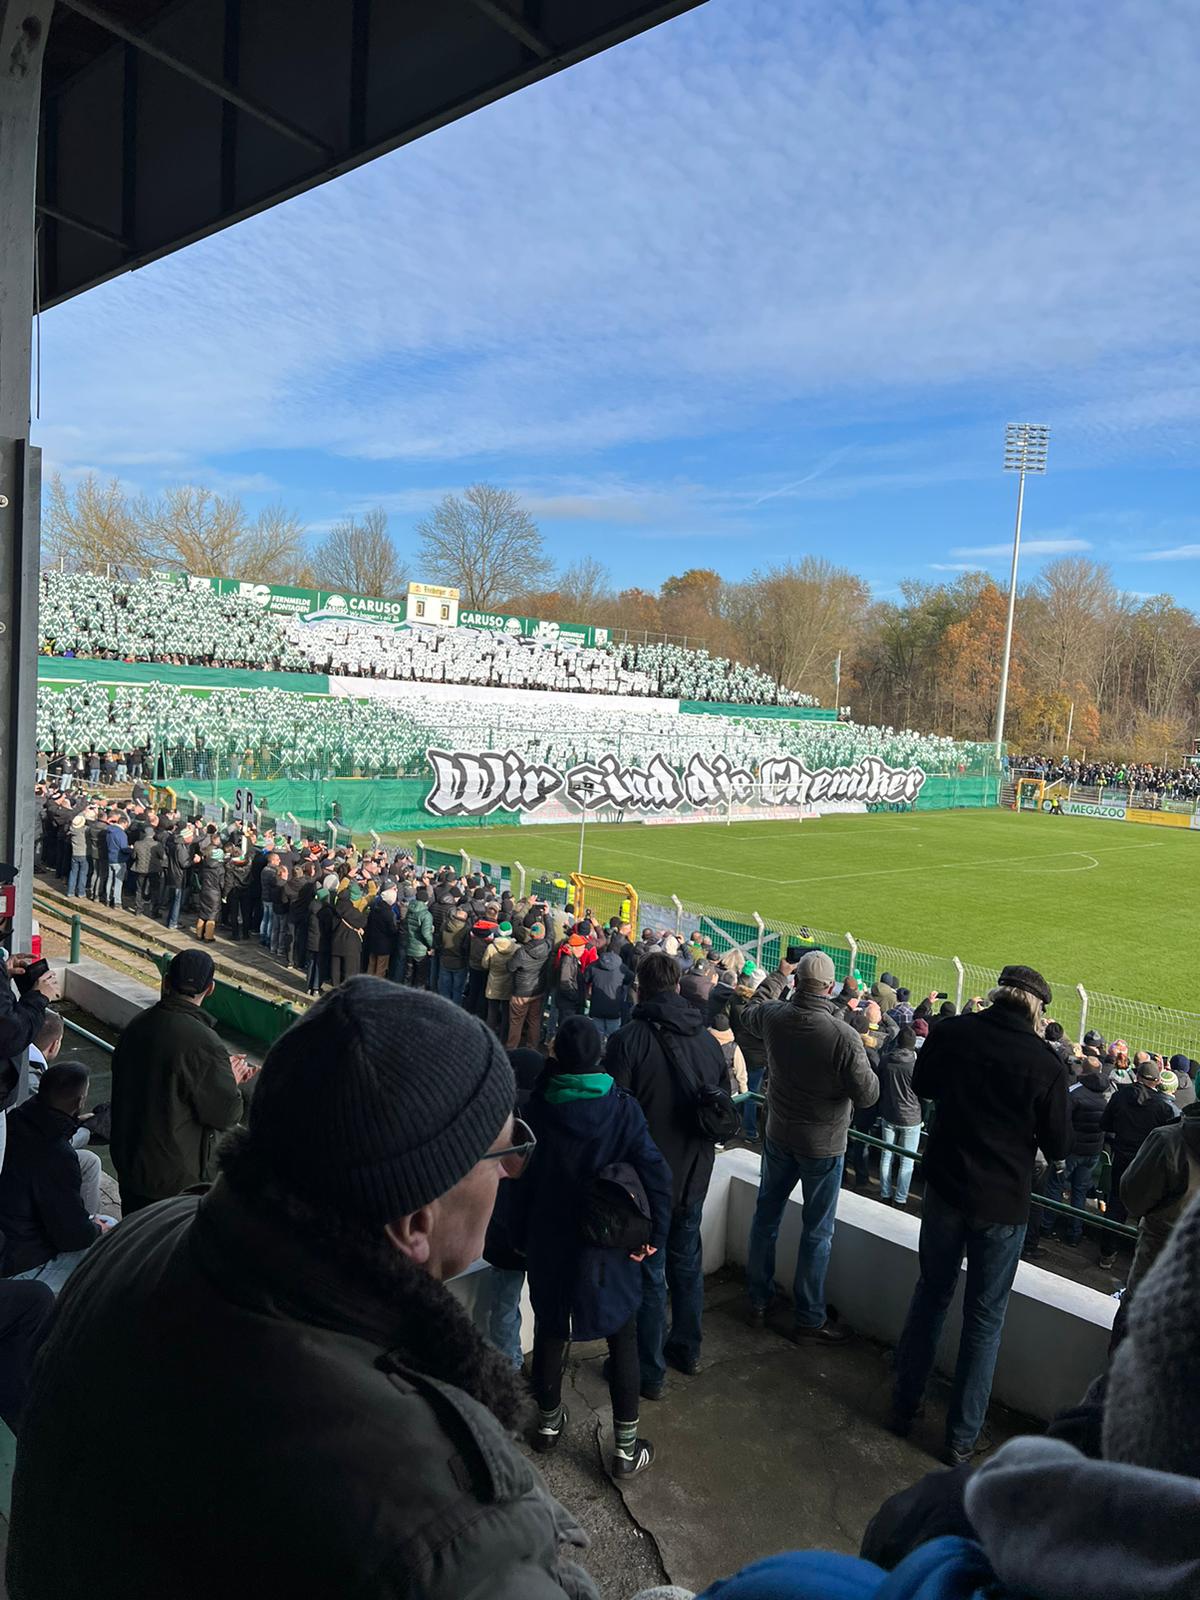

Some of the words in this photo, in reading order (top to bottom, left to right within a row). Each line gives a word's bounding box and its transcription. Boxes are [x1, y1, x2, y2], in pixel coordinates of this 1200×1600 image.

[270, 603, 310, 613] MONTAGEN
[272, 595, 312, 606] FERNMELDE
[349, 598, 401, 615] CARUSO
[460, 612, 504, 627] CARUSO
[426, 749, 563, 816] Wir
[567, 753, 684, 810] sind
[684, 752, 755, 808] die
[760, 756, 924, 804] Chemiker
[236, 790, 241, 810] S
[247, 792, 252, 813] R
[1070, 804, 1125, 818] MEGAZOO
